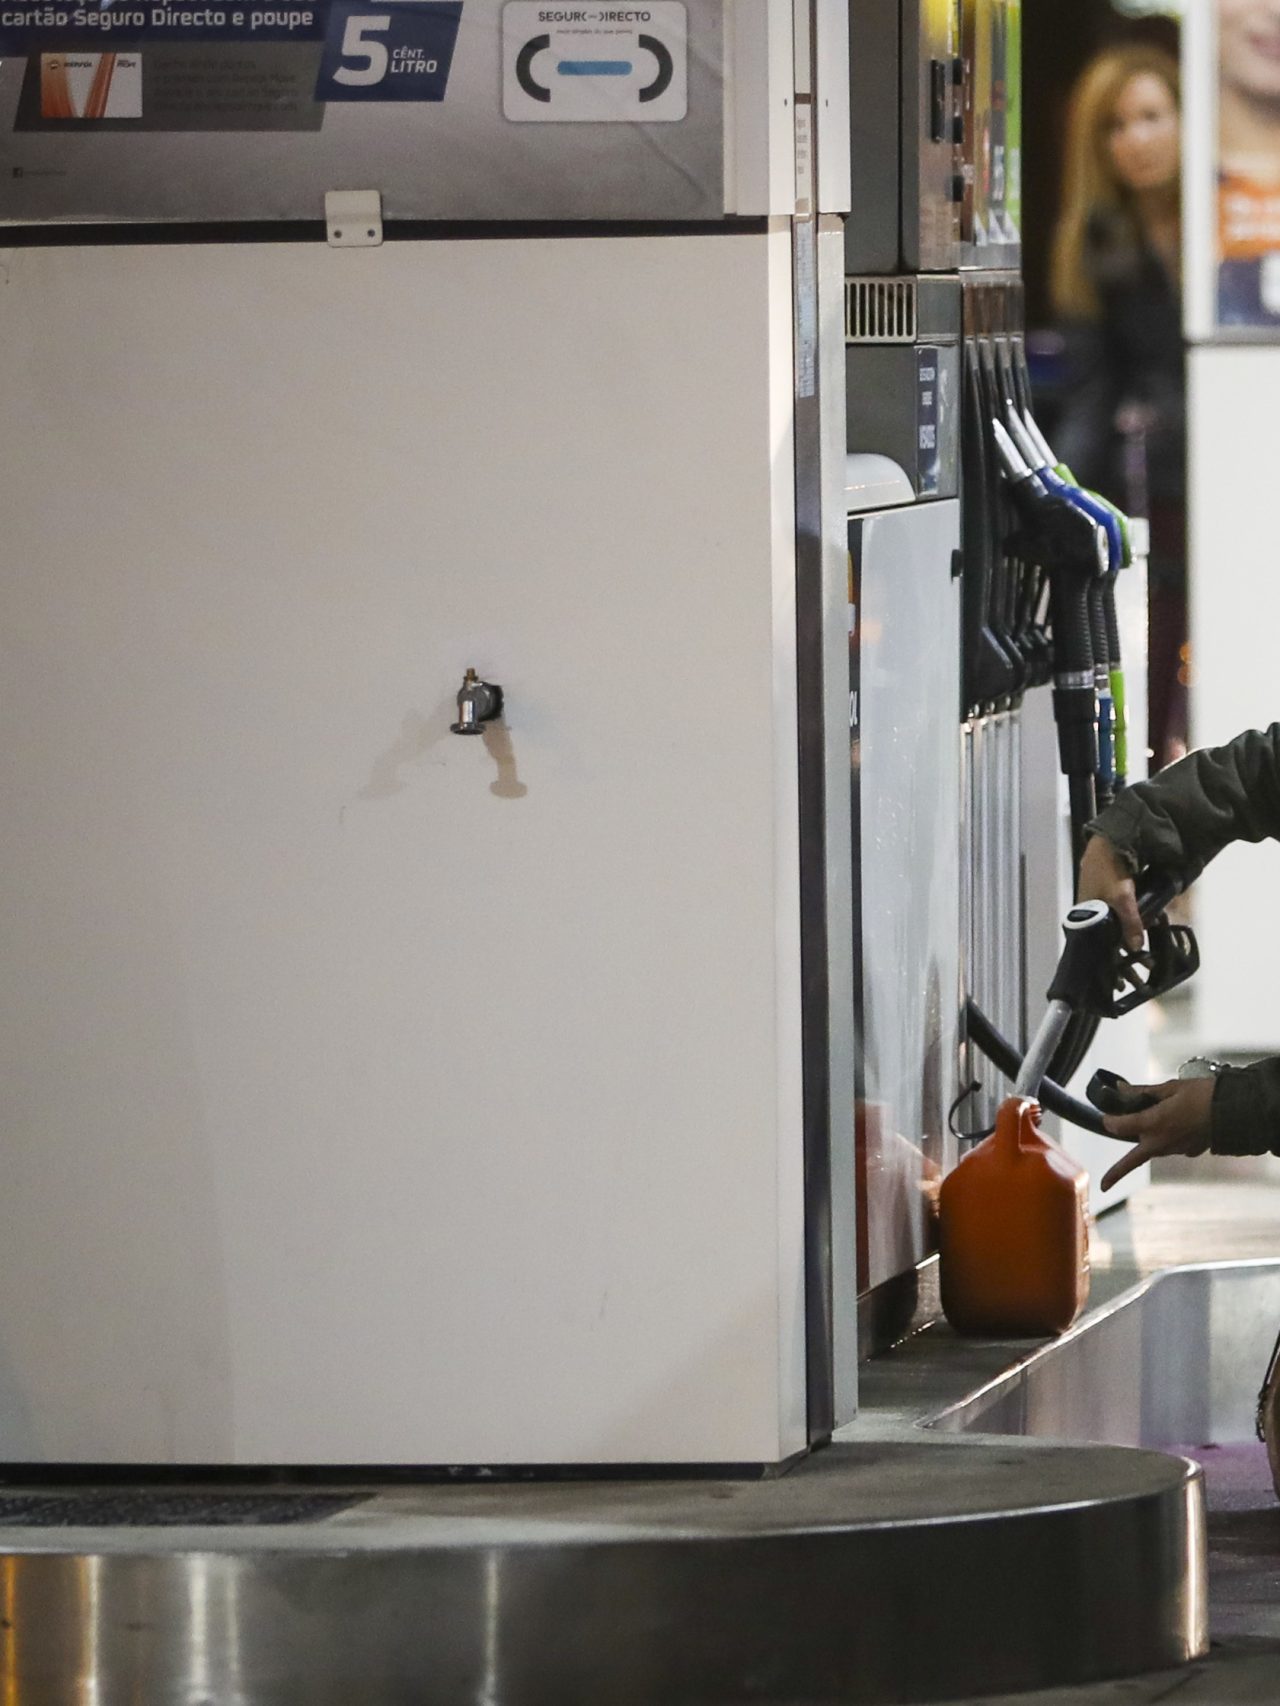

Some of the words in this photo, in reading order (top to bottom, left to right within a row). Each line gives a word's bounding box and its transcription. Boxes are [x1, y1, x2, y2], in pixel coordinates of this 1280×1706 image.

[1, 7, 69, 26] cartão
[74, 9, 145, 31] Seguro
[151, 7, 226, 26] Directo
[232, 11, 245, 26] e
[250, 11, 314, 30] poupe
[332, 15, 391, 86] 5
[392, 45, 426, 59] CÊNT.
[390, 60, 438, 73] LITRO
